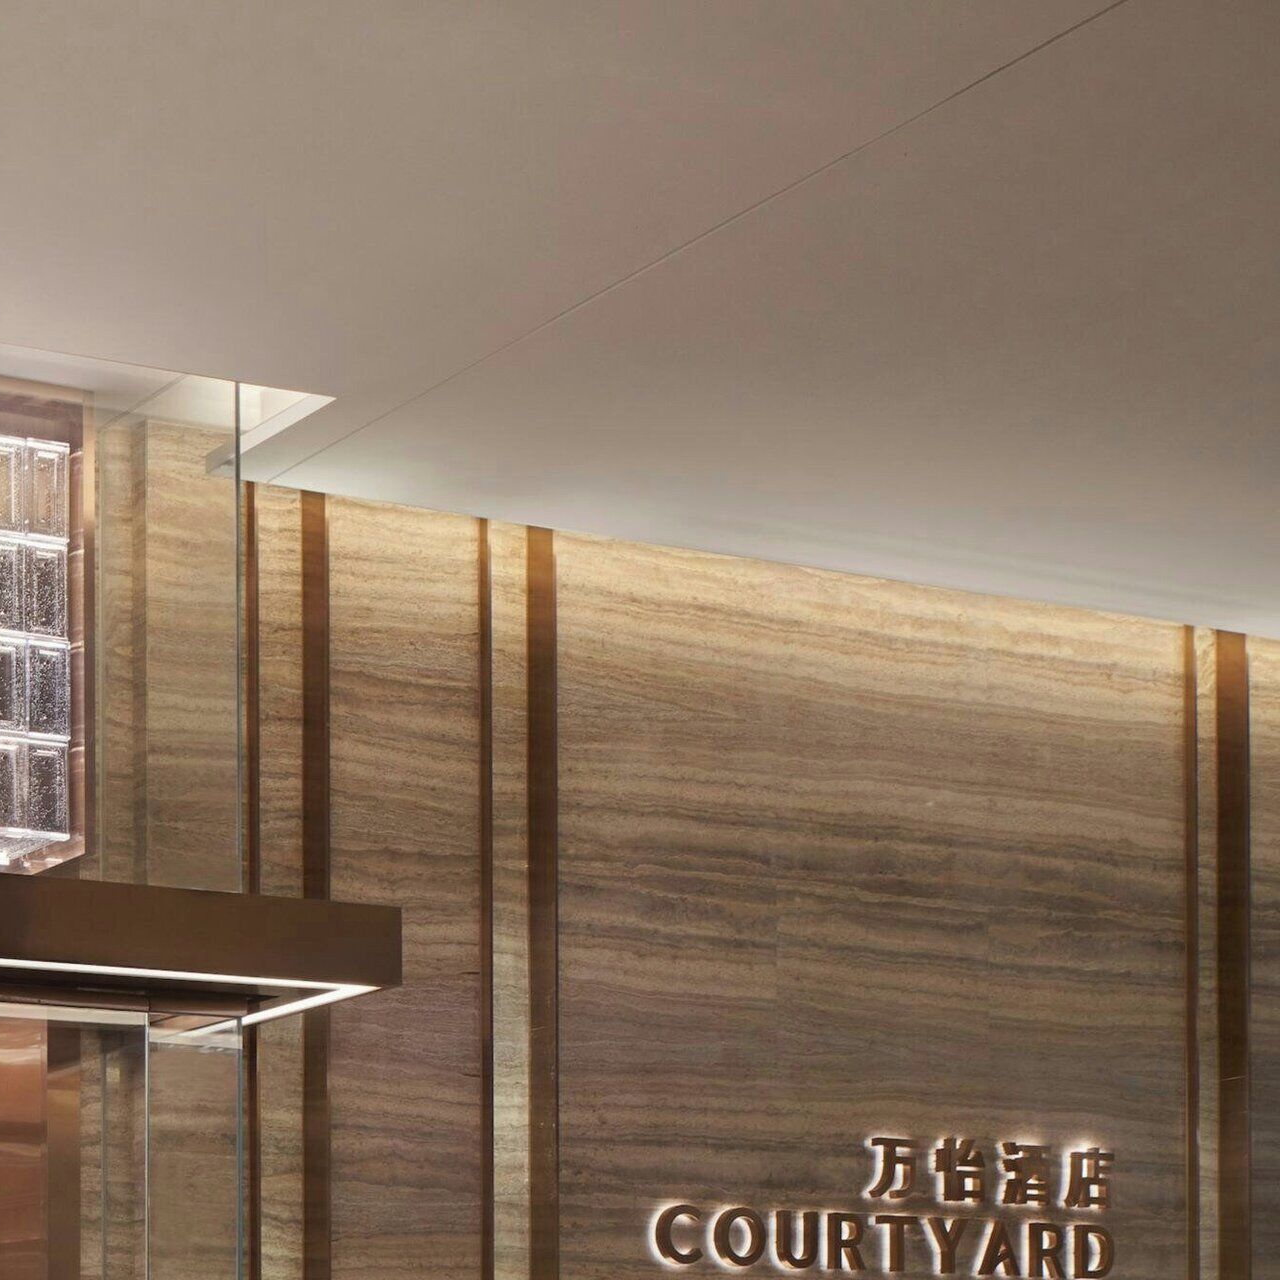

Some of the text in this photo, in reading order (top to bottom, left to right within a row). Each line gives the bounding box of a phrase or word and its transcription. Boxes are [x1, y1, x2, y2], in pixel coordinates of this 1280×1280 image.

[867, 1137, 1115, 1208] 万怡酒店
[653, 1203, 1116, 1280] COURTYARD
